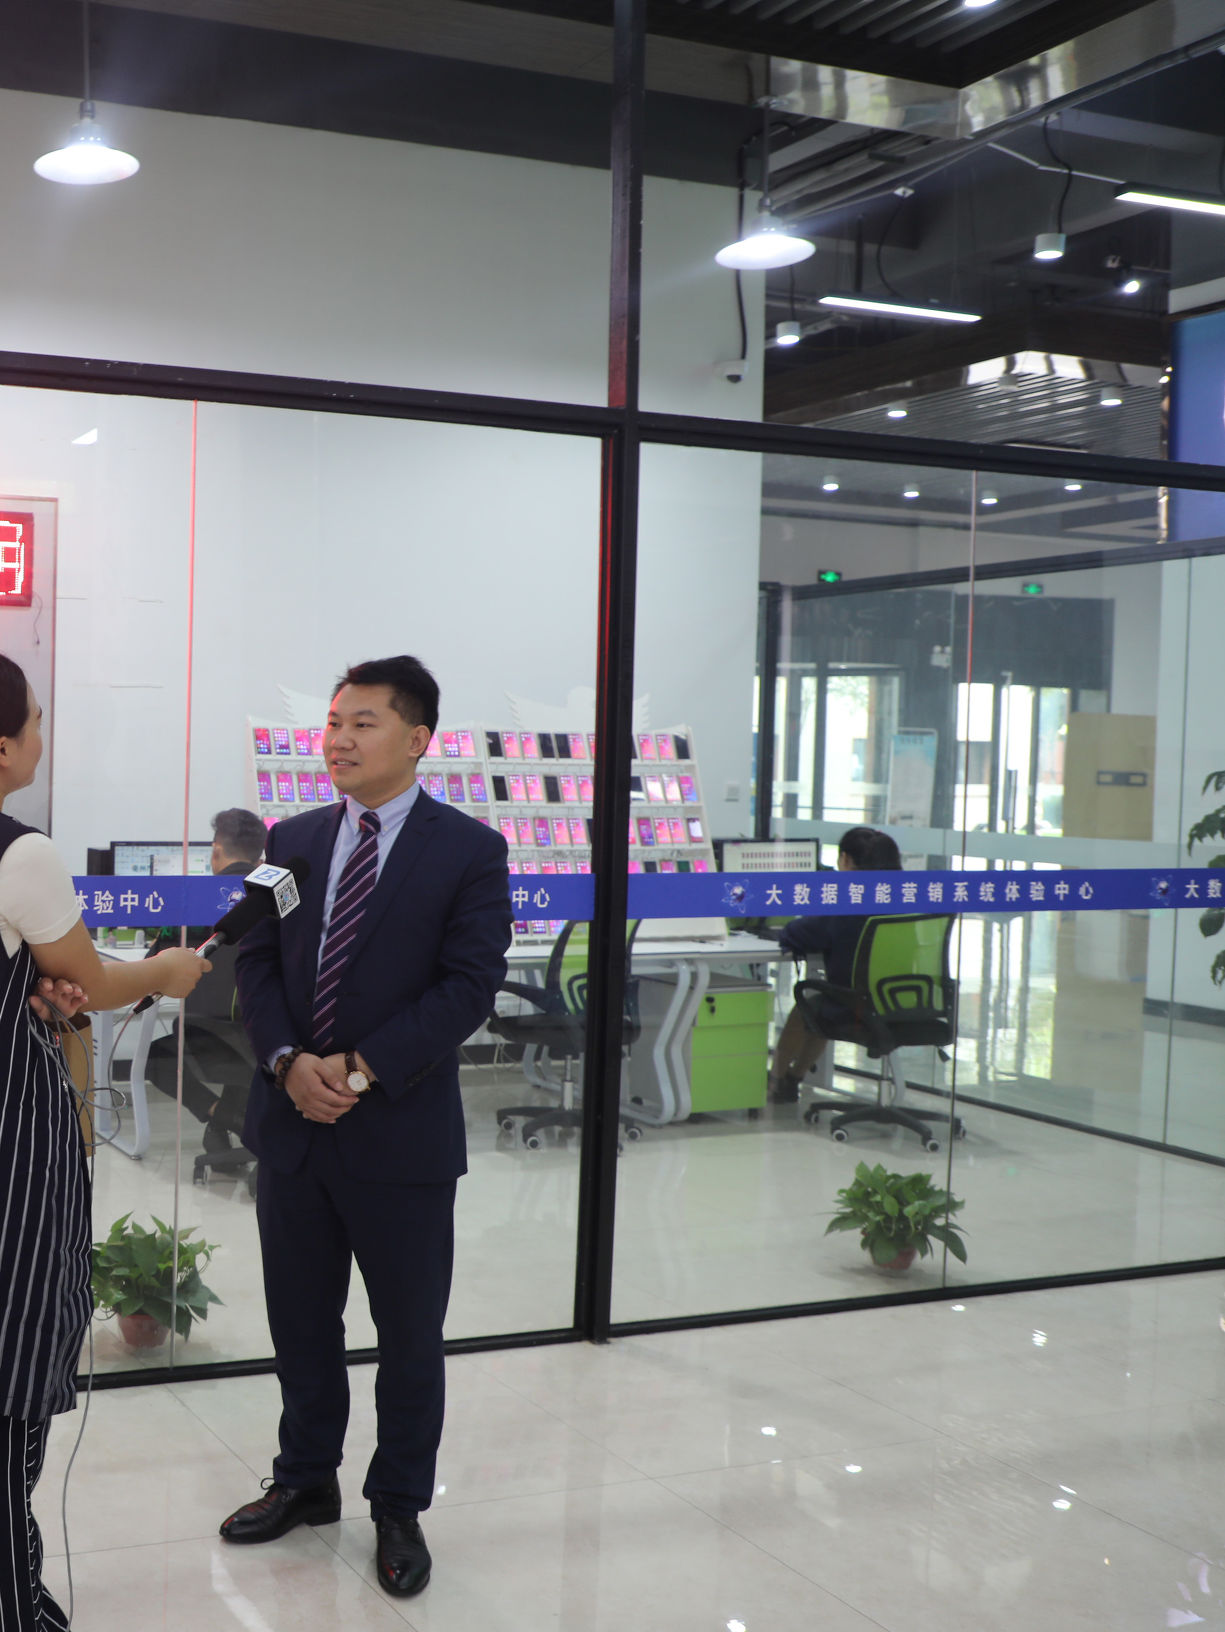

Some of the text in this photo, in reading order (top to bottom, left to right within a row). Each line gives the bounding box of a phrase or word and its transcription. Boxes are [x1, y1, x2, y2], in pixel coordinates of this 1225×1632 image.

[512, 886, 551, 909] 中心
[765, 881, 1094, 906] 大数据智能营销系统体验中心
[1184, 879, 1222, 899] 大数
